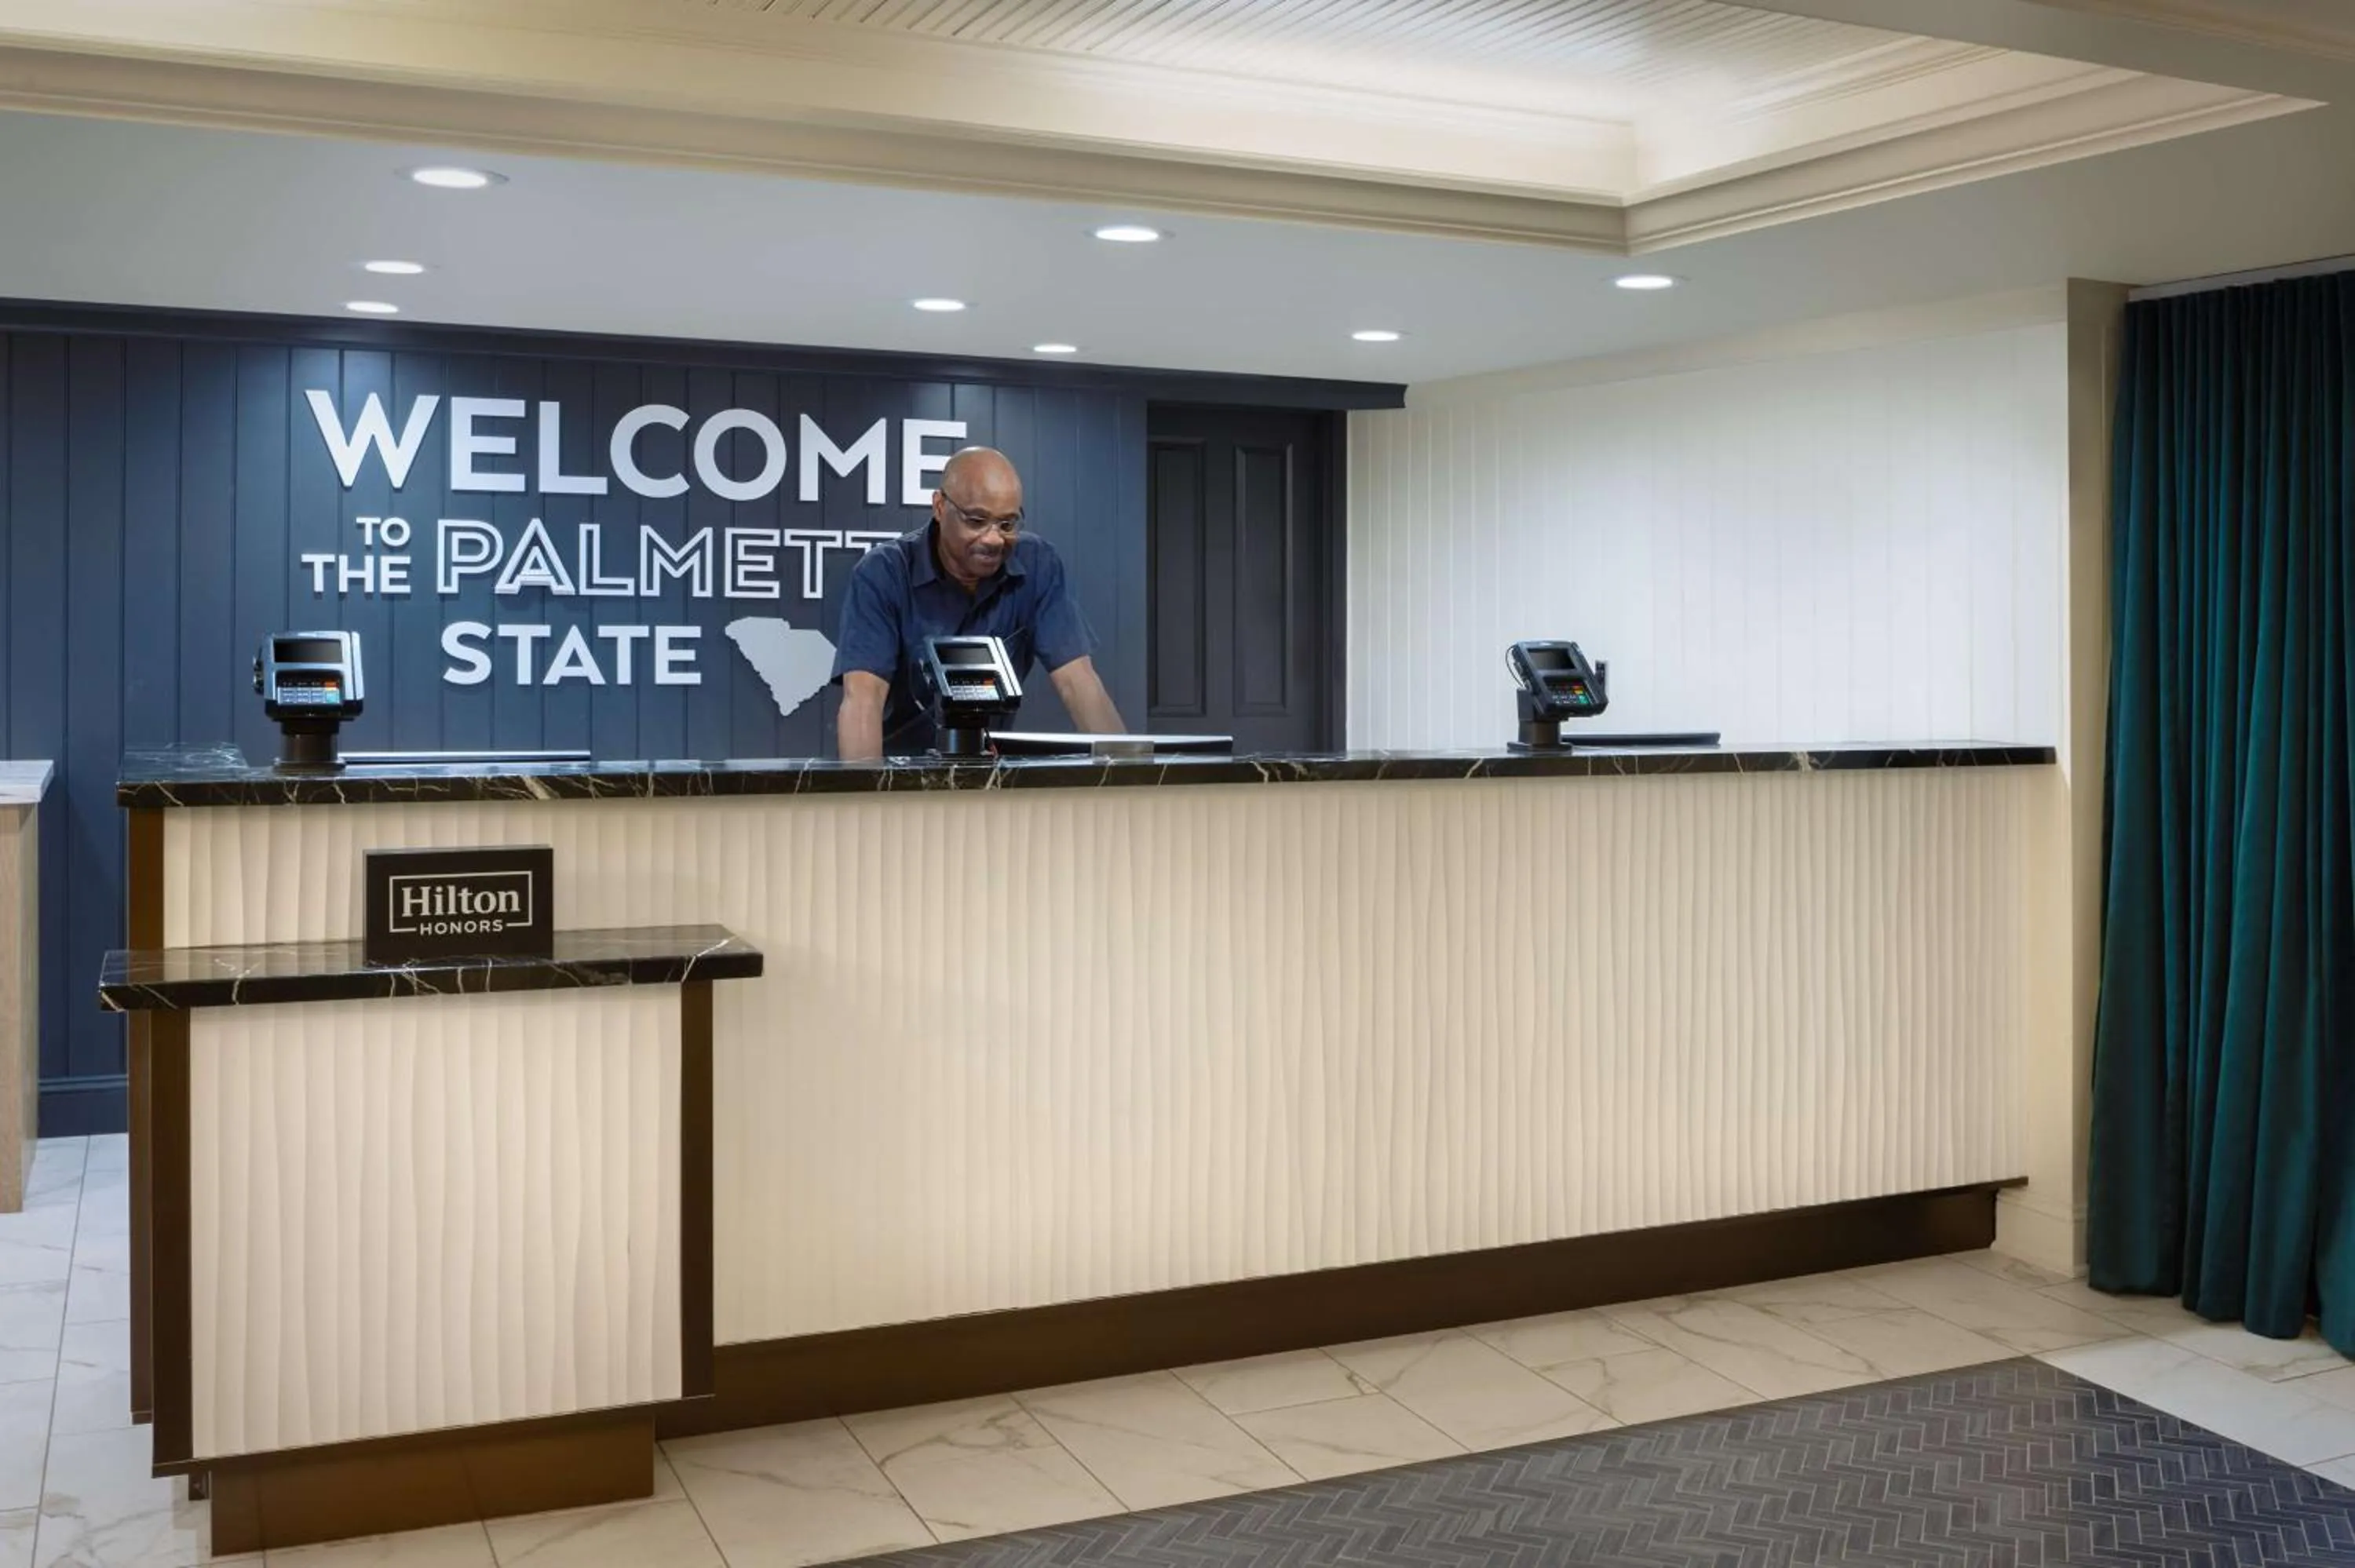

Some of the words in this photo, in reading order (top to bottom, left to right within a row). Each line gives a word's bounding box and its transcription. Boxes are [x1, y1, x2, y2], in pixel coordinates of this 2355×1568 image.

[305, 390, 967, 505] WELCOME
[356, 516, 411, 547] TO
[301, 553, 411, 593] THE
[440, 621, 702, 685] STATE
[401, 884, 520, 917] Hilton
[419, 919, 504, 935] HONORS
